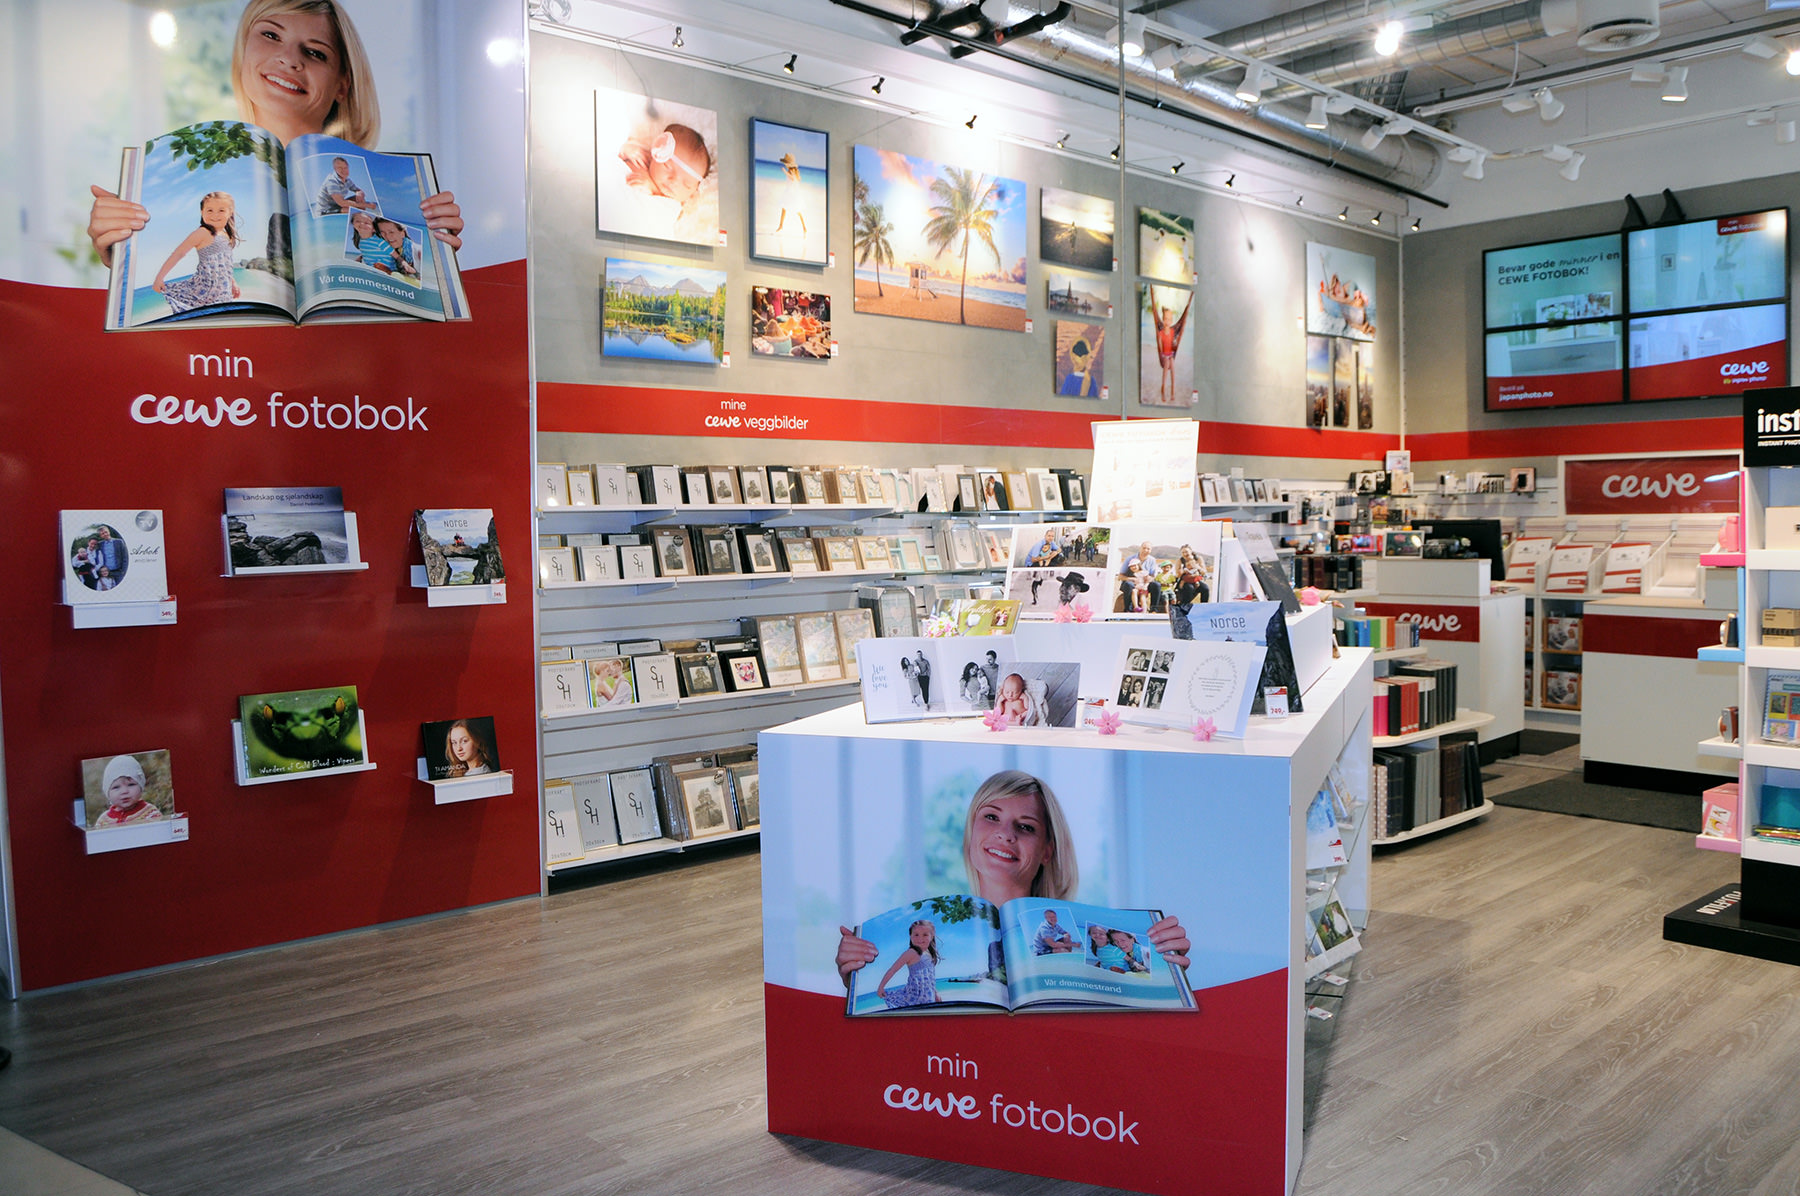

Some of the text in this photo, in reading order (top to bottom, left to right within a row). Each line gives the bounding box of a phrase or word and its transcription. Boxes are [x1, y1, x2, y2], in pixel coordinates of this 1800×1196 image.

[1498, 265, 1526, 275] Bevar
[1529, 259, 1556, 272] gode
[1606, 251, 1620, 259] en
[318, 274, 416, 301] Vår drømmestrand
[1498, 267, 1590, 286] CEWE FOTOBOK!
[189, 348, 253, 378] min
[1720, 361, 1770, 376] cewe
[130, 391, 429, 431] cewe fotobok
[720, 398, 747, 411] mine
[704, 414, 809, 432] cewe veggbilder
[243, 493, 275, 501] Landskap
[275, 494, 285, 502] og
[1601, 472, 1701, 499] cewe
[260, 766, 285, 774] Wonders
[287, 762, 295, 770] of
[296, 761, 311, 769] Cold
[312, 758, 331, 768] Blood
[1696, 891, 1742, 915] UJIFILM
[1044, 977, 1122, 995] Vår drømmestrand
[927, 1052, 978, 1080] min
[884, 1084, 1139, 1146] cewe fotobok
